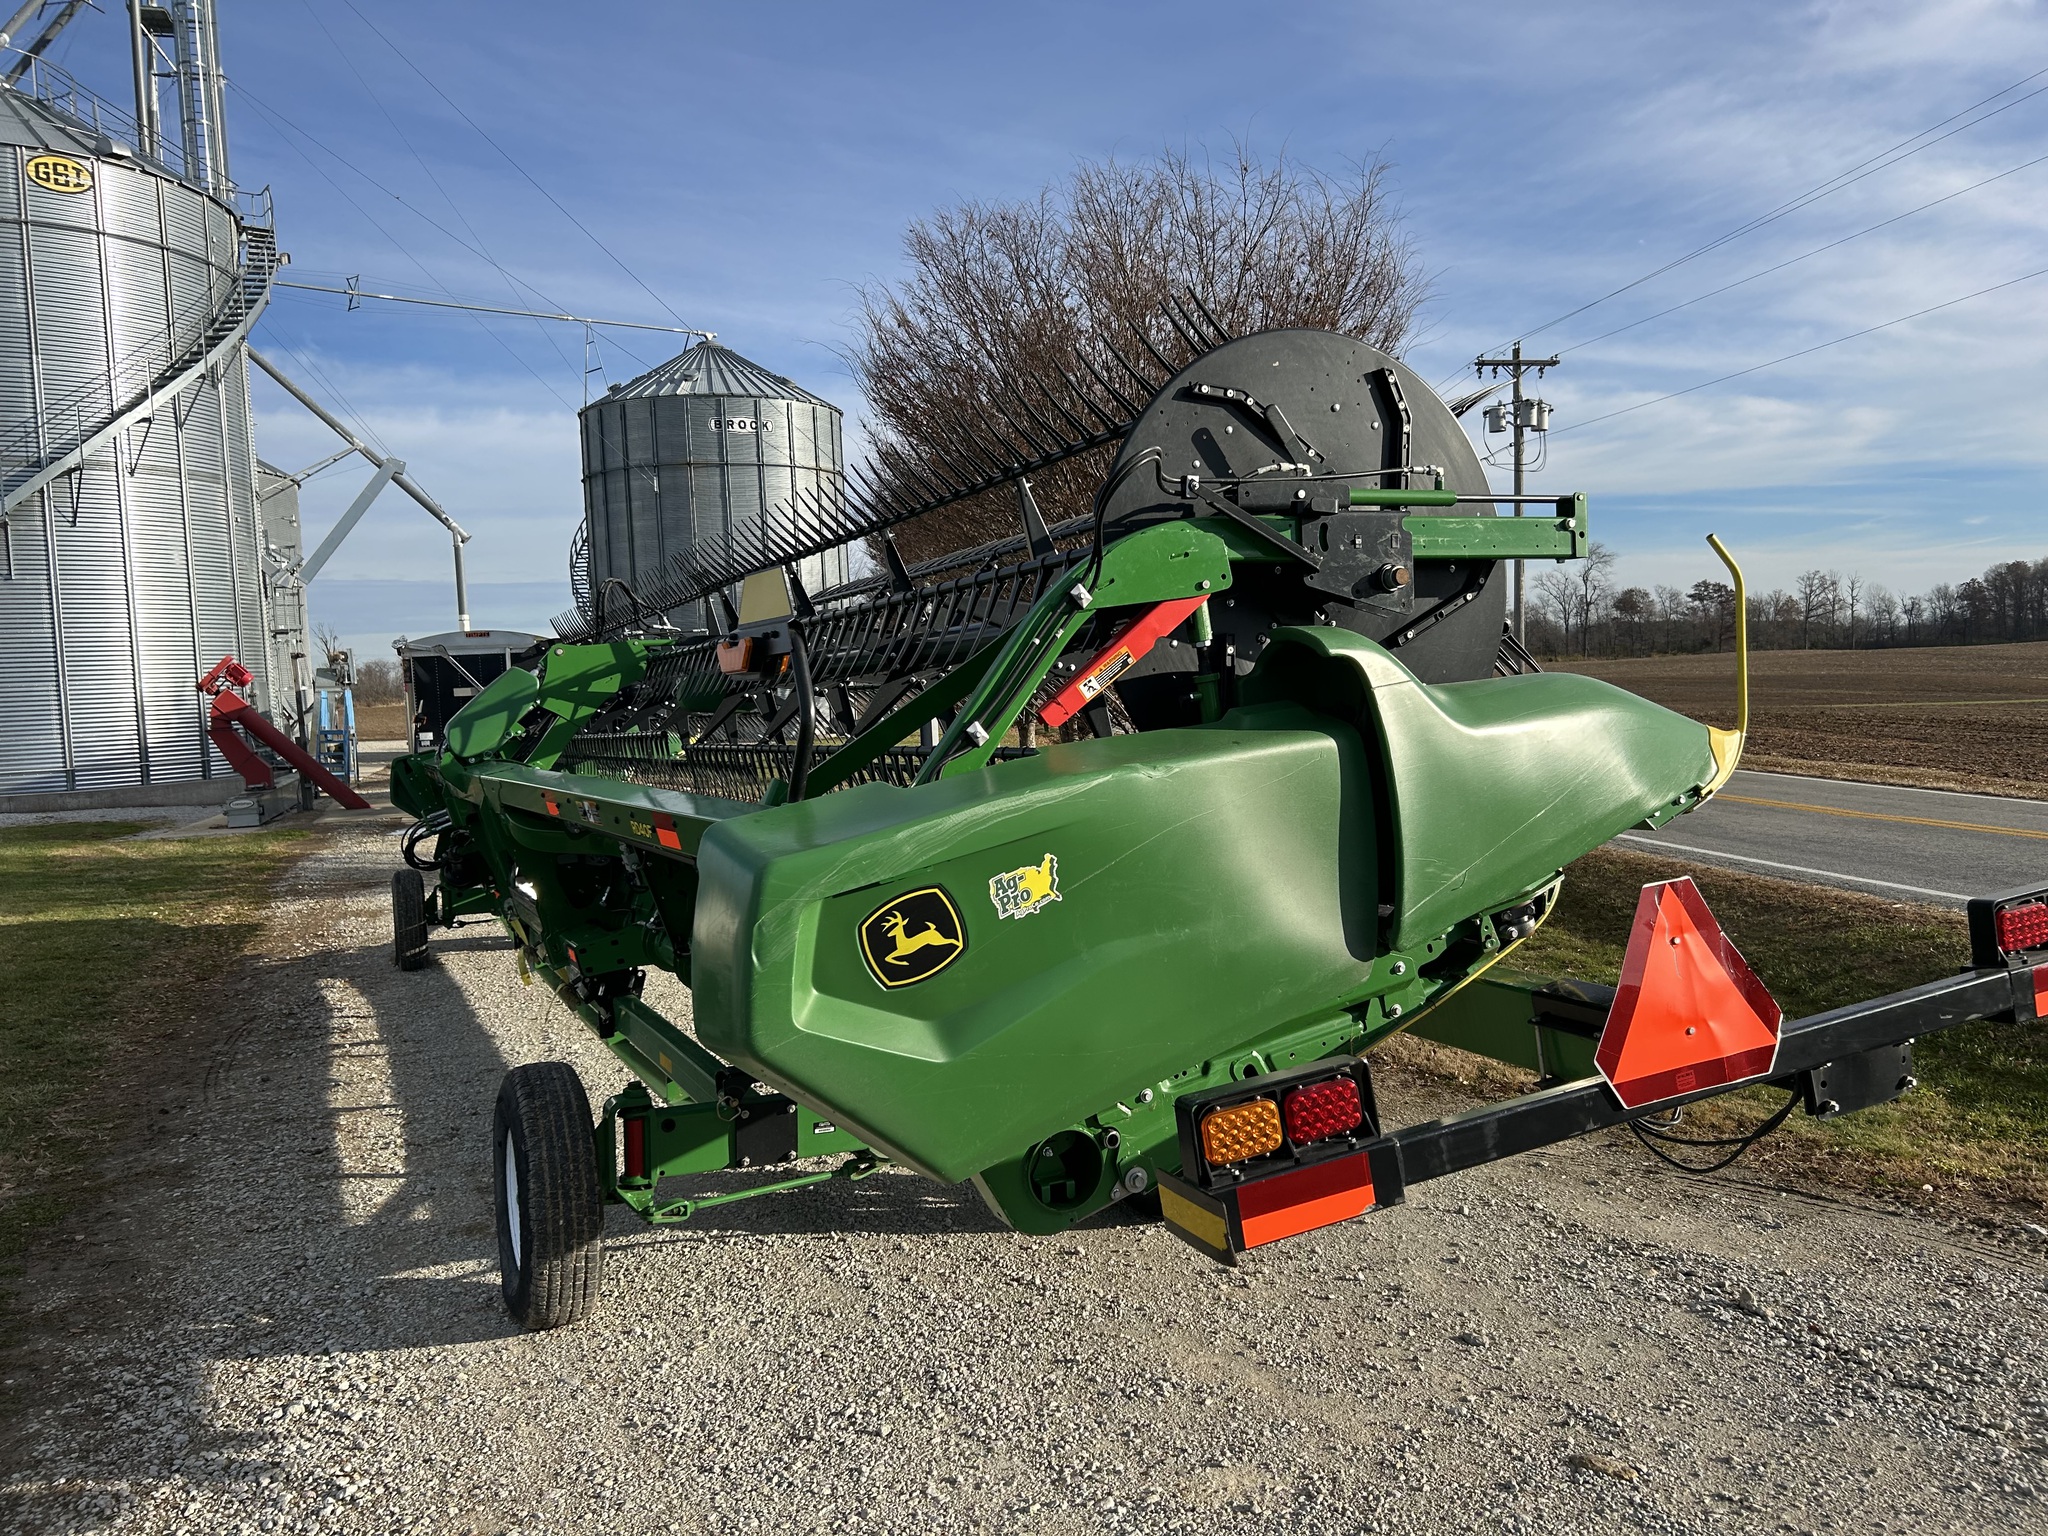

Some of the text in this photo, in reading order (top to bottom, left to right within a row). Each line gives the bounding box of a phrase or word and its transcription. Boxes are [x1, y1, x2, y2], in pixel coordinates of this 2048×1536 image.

[35, 162, 84, 187] GSI
[714, 419, 769, 431] BROCK
[994, 874, 1025, 898] Ag-
[998, 889, 1031, 914] Pro
